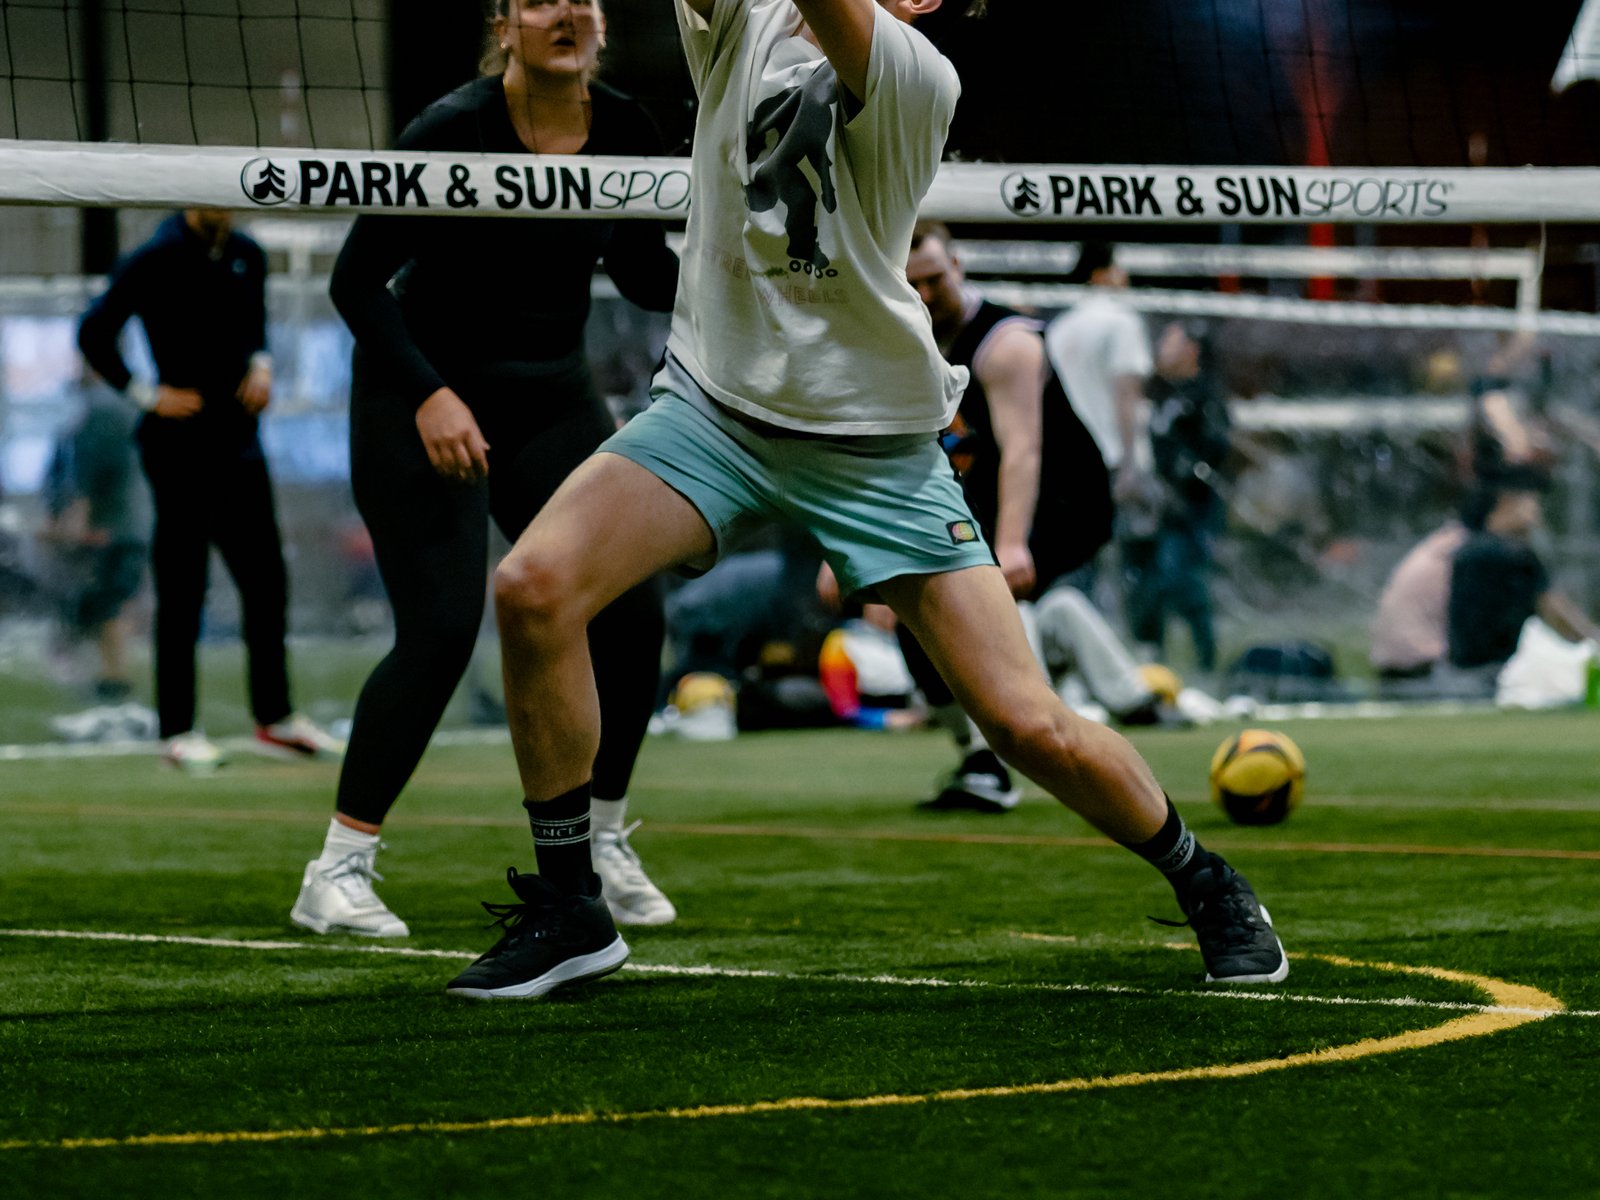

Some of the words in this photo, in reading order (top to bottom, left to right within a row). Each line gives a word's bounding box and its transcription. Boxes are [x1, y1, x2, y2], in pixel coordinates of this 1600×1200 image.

[299, 161, 429, 208] PARK
[446, 164, 480, 210] &
[495, 166, 591, 211] SUN
[594, 170, 691, 211] SPO
[1049, 176, 1161, 217] PARK
[1176, 177, 1204, 217] &
[1217, 177, 1301, 217] SUN
[1302, 177, 1448, 217] SPORTS
